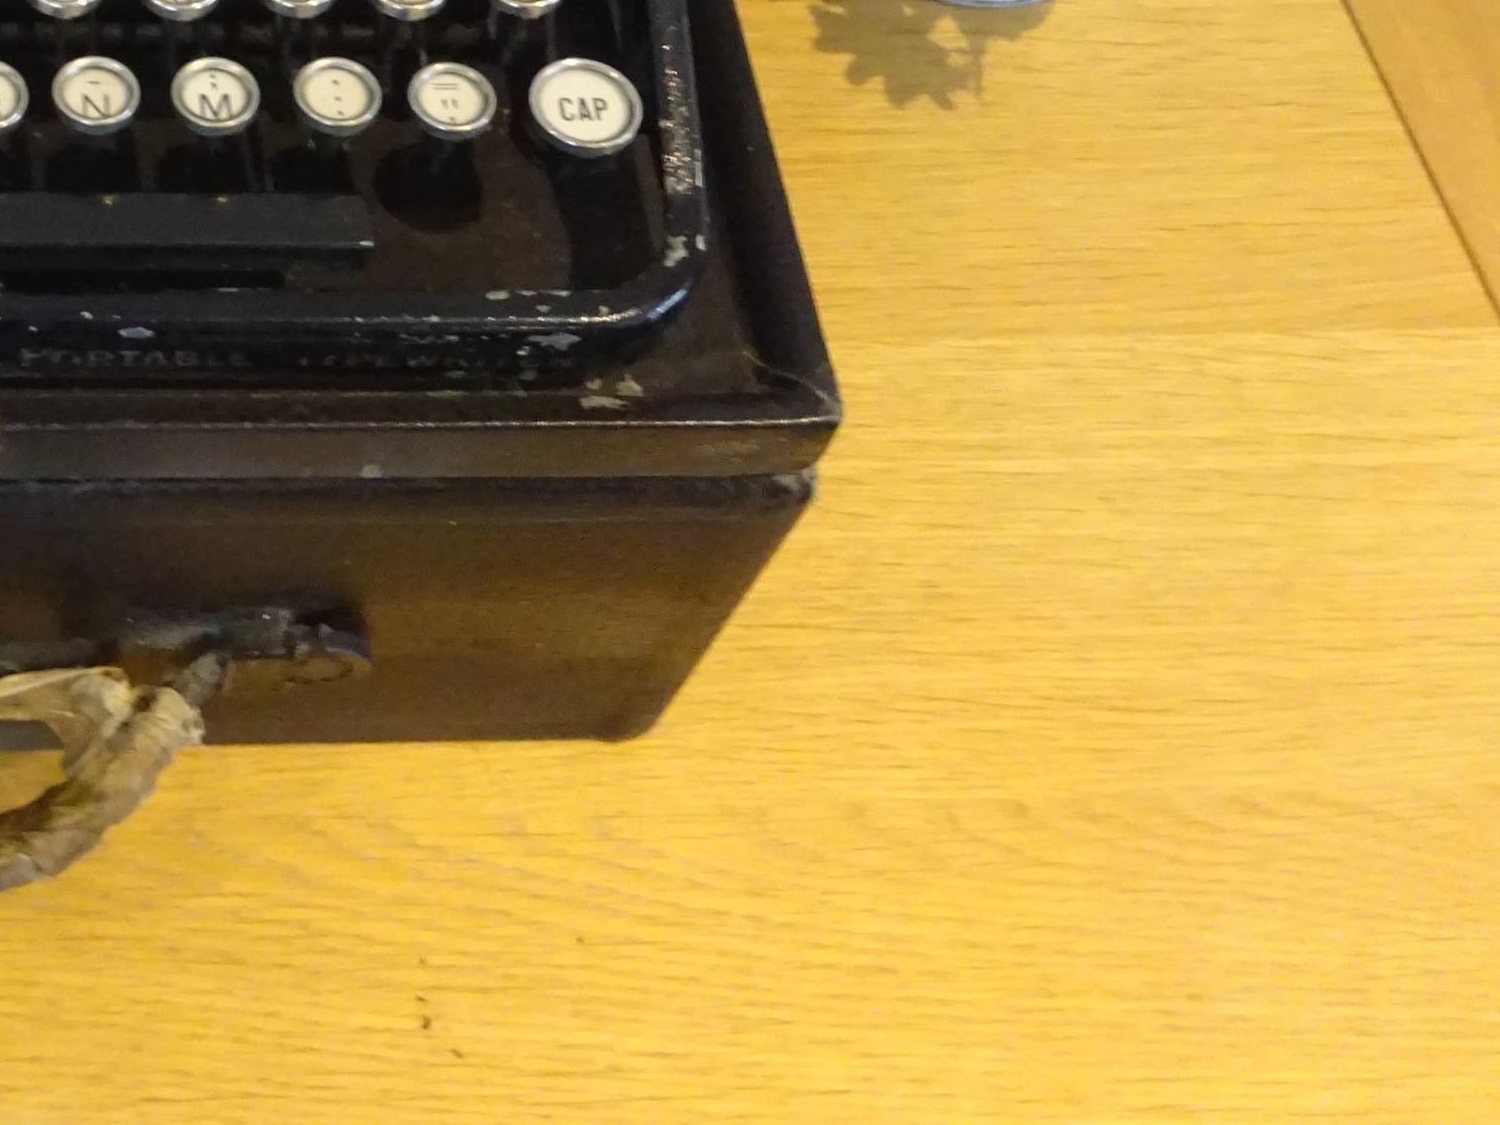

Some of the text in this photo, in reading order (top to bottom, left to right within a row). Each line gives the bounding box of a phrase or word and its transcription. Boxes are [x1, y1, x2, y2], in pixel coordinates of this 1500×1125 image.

[81, 92, 111, 119] N
[197, 92, 233, 120] M
[556, 96, 610, 122] CAP
